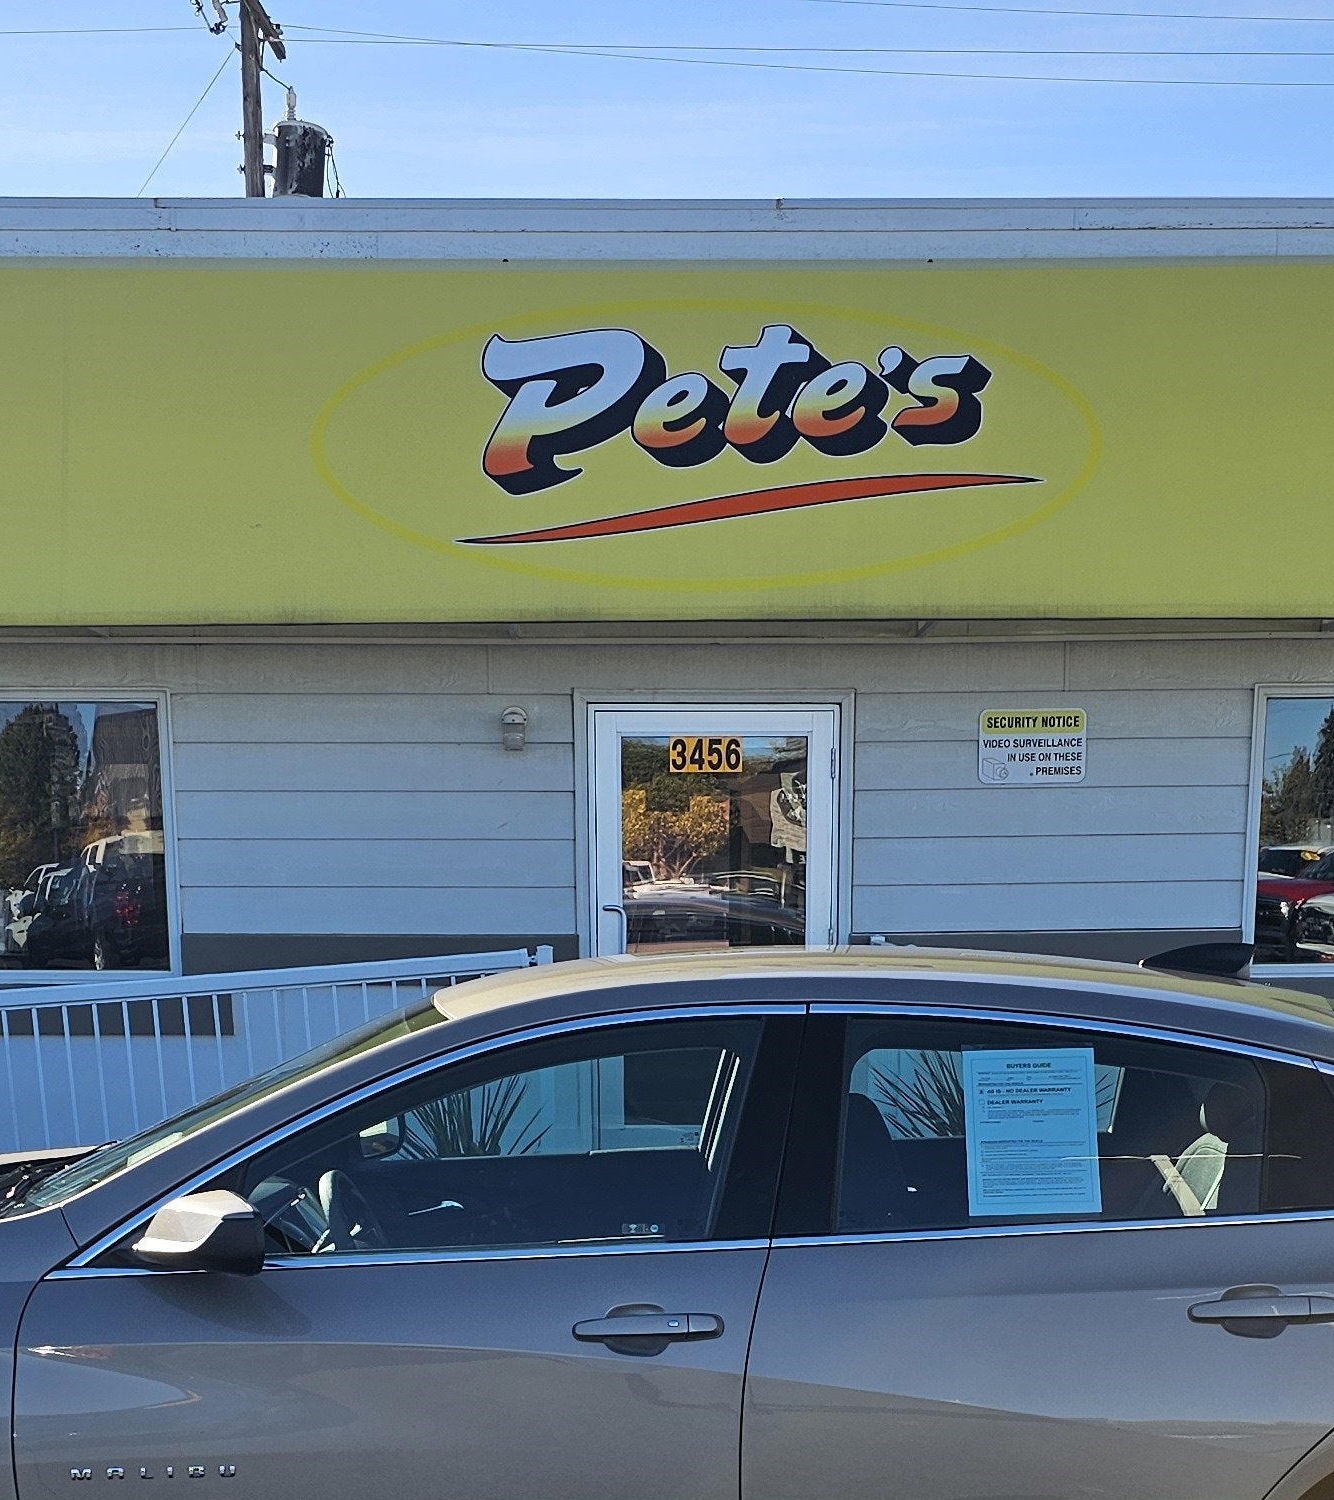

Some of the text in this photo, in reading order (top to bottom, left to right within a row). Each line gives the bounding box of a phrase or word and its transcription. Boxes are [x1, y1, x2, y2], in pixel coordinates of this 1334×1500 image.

[481, 322, 992, 496] Pete's
[986, 716, 1080, 728] SECURITY NOTICE
[983, 738, 1082, 748] VIDEO SURVEILLANCE
[671, 738, 741, 770] 3456
[1007, 752, 1082, 761] IN USE ON THESE
[1036, 766, 1081, 776] PREMISES
[70, 1465, 236, 1480] MALIBU
